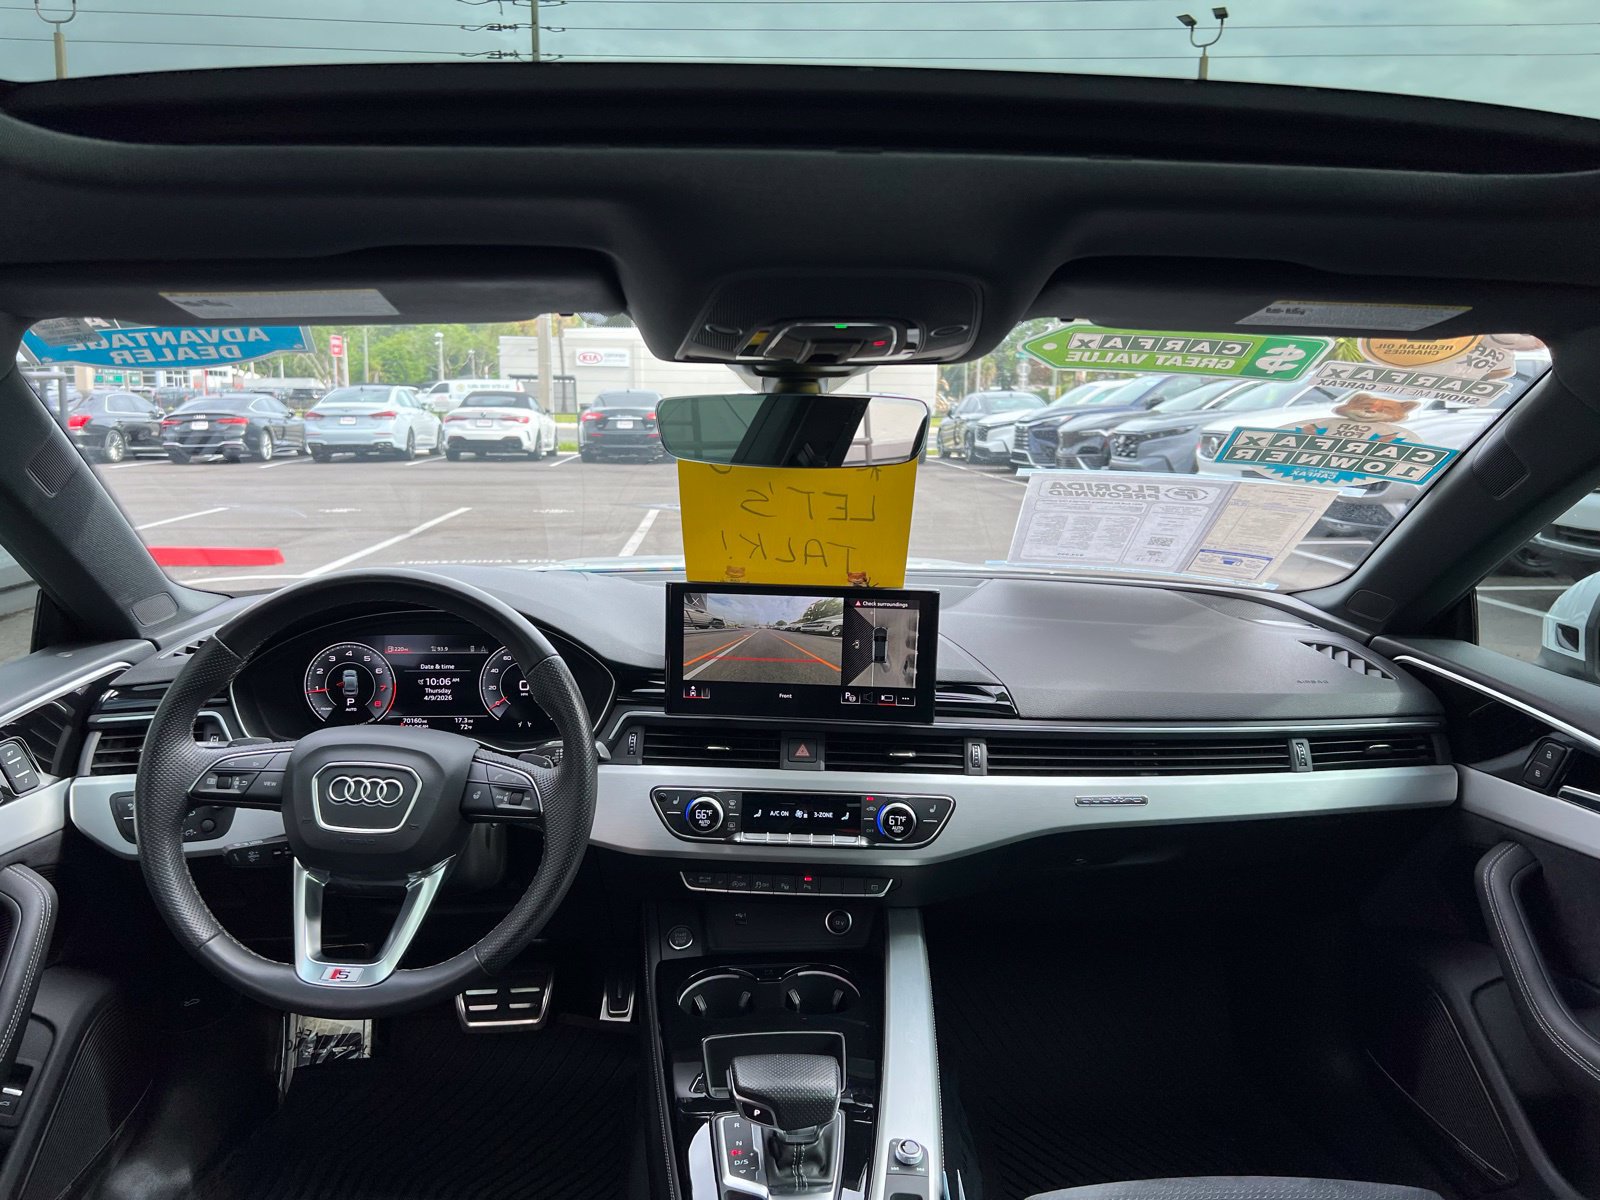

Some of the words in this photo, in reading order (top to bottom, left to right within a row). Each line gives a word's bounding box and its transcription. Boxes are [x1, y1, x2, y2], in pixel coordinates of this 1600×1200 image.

[425, 677, 451, 686] 10:06
[347, 698, 355, 706] P
[813, 811, 834, 819] 3-ZONE
